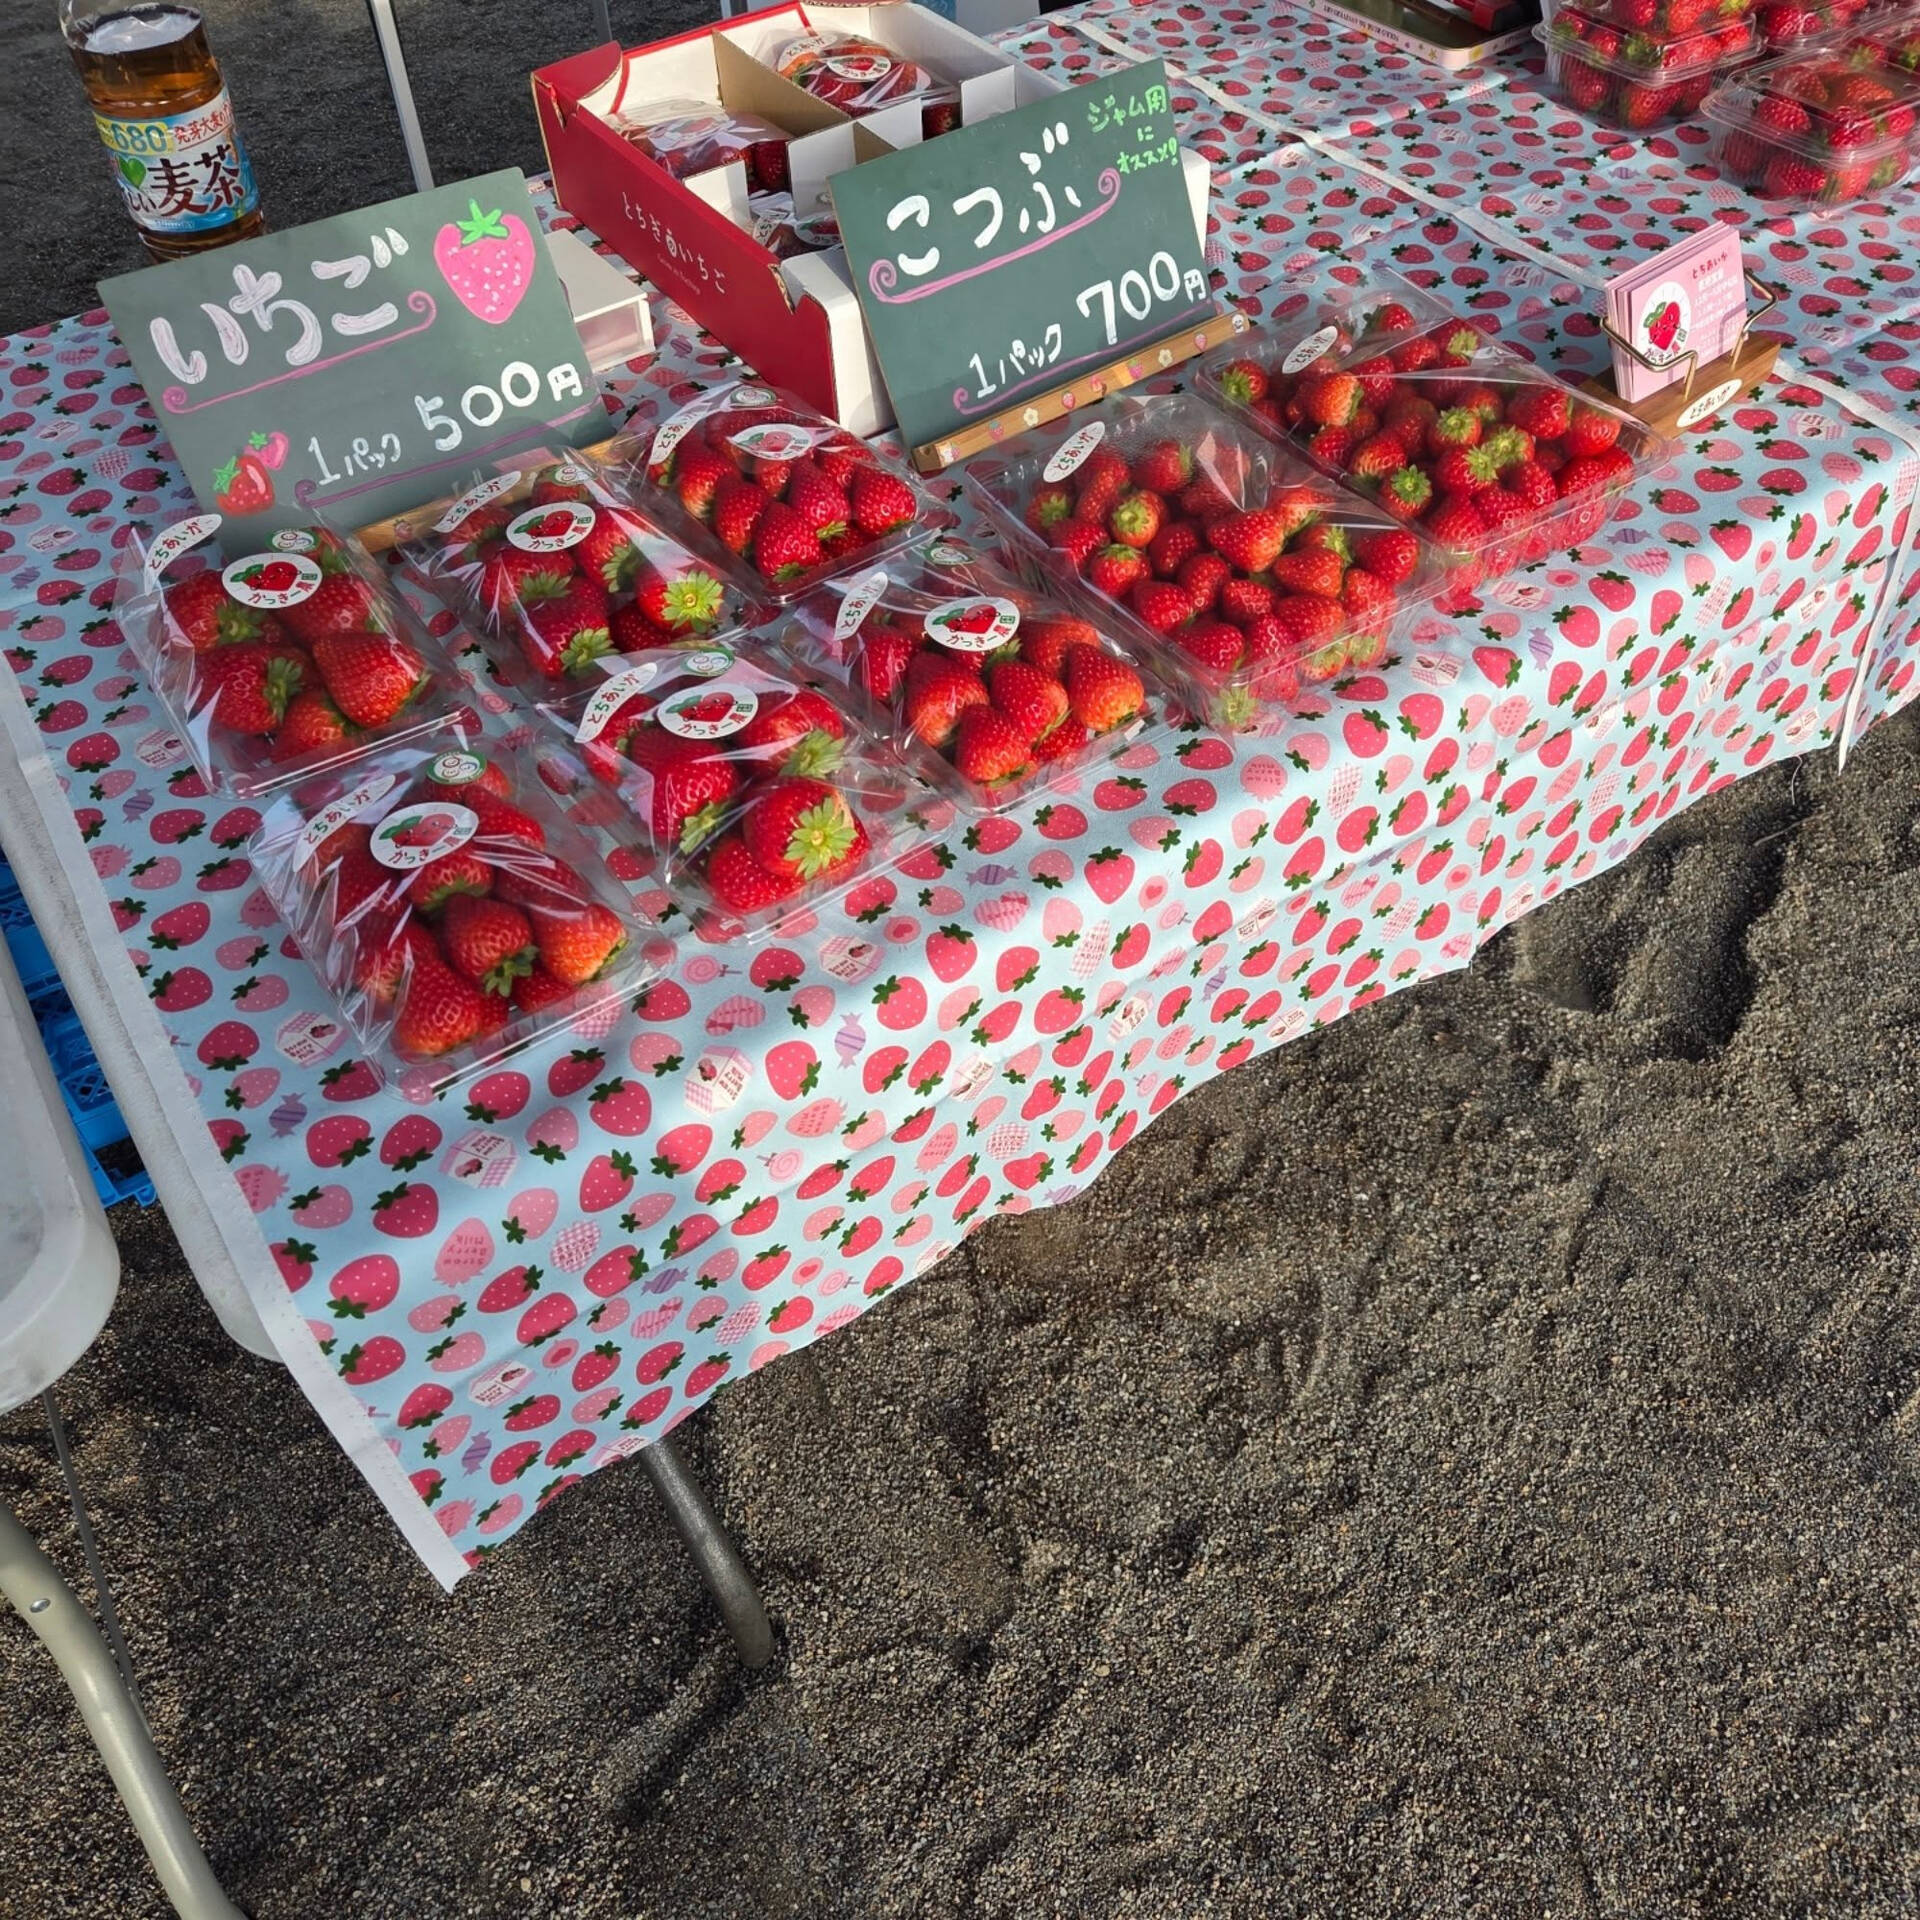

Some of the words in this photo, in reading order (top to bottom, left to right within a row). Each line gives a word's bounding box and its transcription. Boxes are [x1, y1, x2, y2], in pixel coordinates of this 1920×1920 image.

[1087, 85, 1167, 133] ジャム用
[110, 123, 168, 153] 680
[1137, 126, 1154, 142] に
[886, 121, 1082, 276] こつぶ
[150, 227, 409, 384] いちご
[968, 323, 1062, 399] 1パック
[1076, 251, 1207, 345] 700円
[308, 433, 402, 486] 1パック
[414, 360, 583, 451] 500円
[1053, 431, 1094, 471] とちあいか
[447, 480, 502, 525] とちあいか
[149, 522, 203, 570] とちあいか
[588, 673, 641, 724] とちあいか
[303, 789, 370, 846] とちあいか
